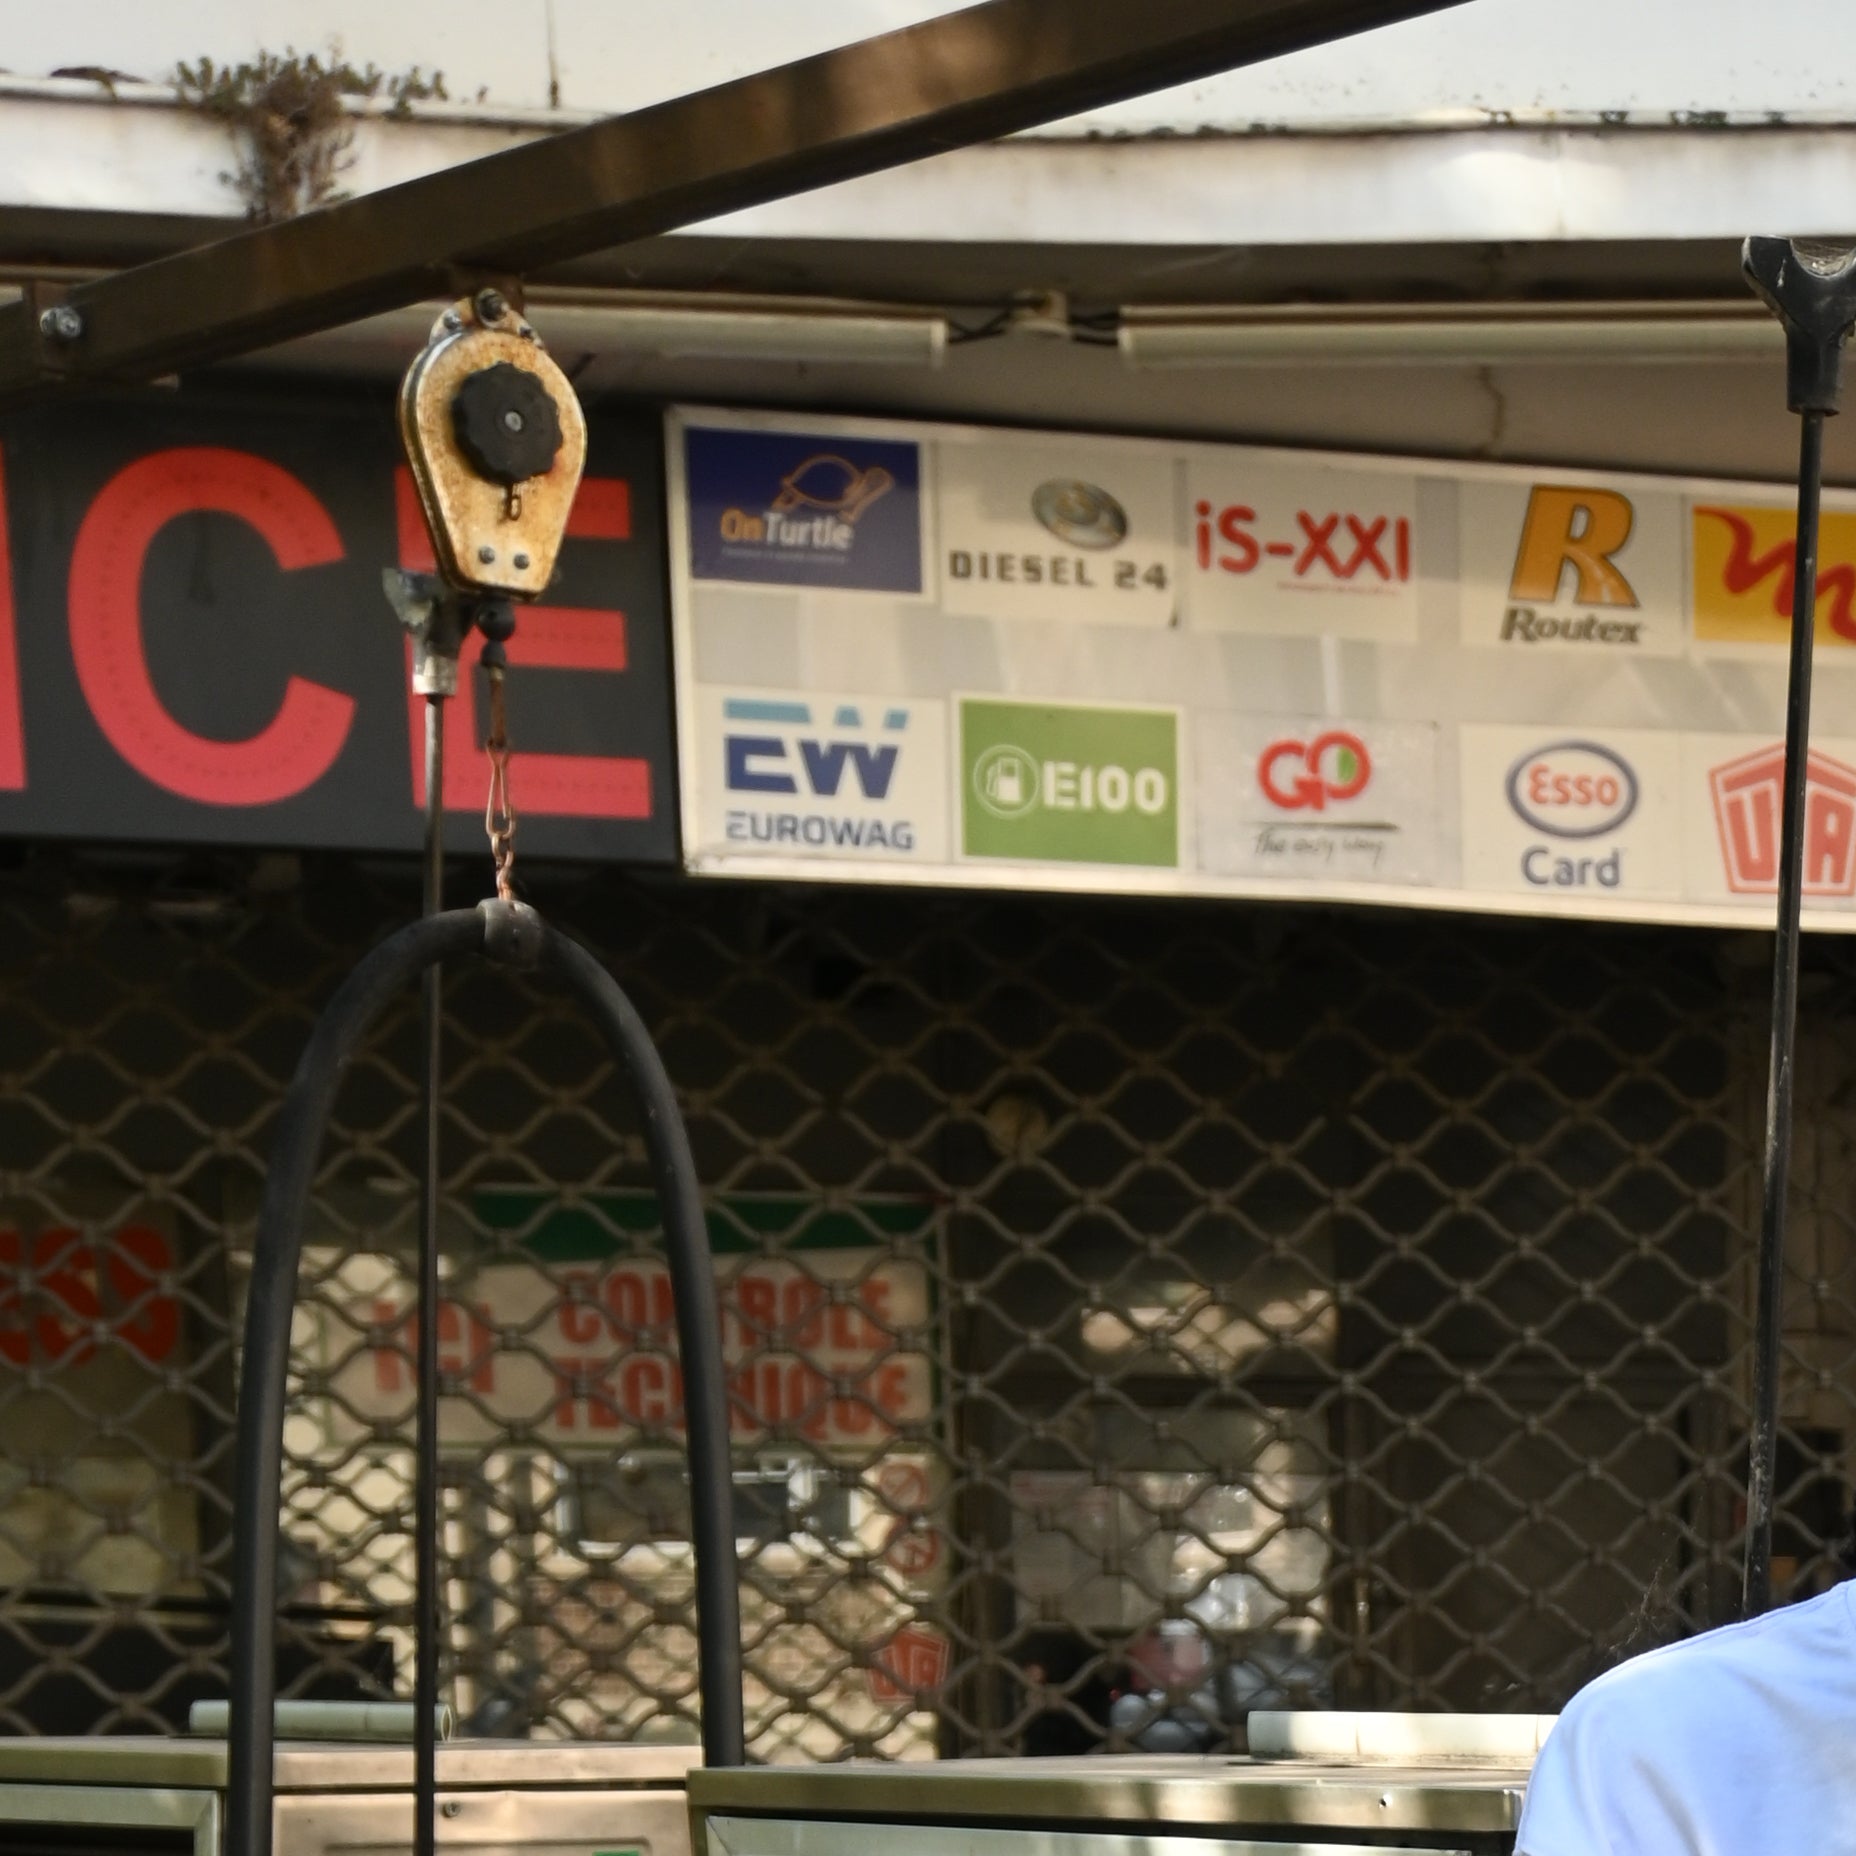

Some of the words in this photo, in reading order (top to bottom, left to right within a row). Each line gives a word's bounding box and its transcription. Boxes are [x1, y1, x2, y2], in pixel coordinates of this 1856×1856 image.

[720, 507, 855, 551] OnTurtle
[949, 550, 1097, 586] DIESEL
[1114, 559, 1168, 591] 24
[0, 446, 652, 820] CE
[1501, 606, 1643, 645] Routex
[1257, 730, 1371, 812] GO
[725, 811, 914, 852] EUROWAG
[1521, 845, 1623, 888] Card
[558, 1270, 895, 1349] CONROLE
